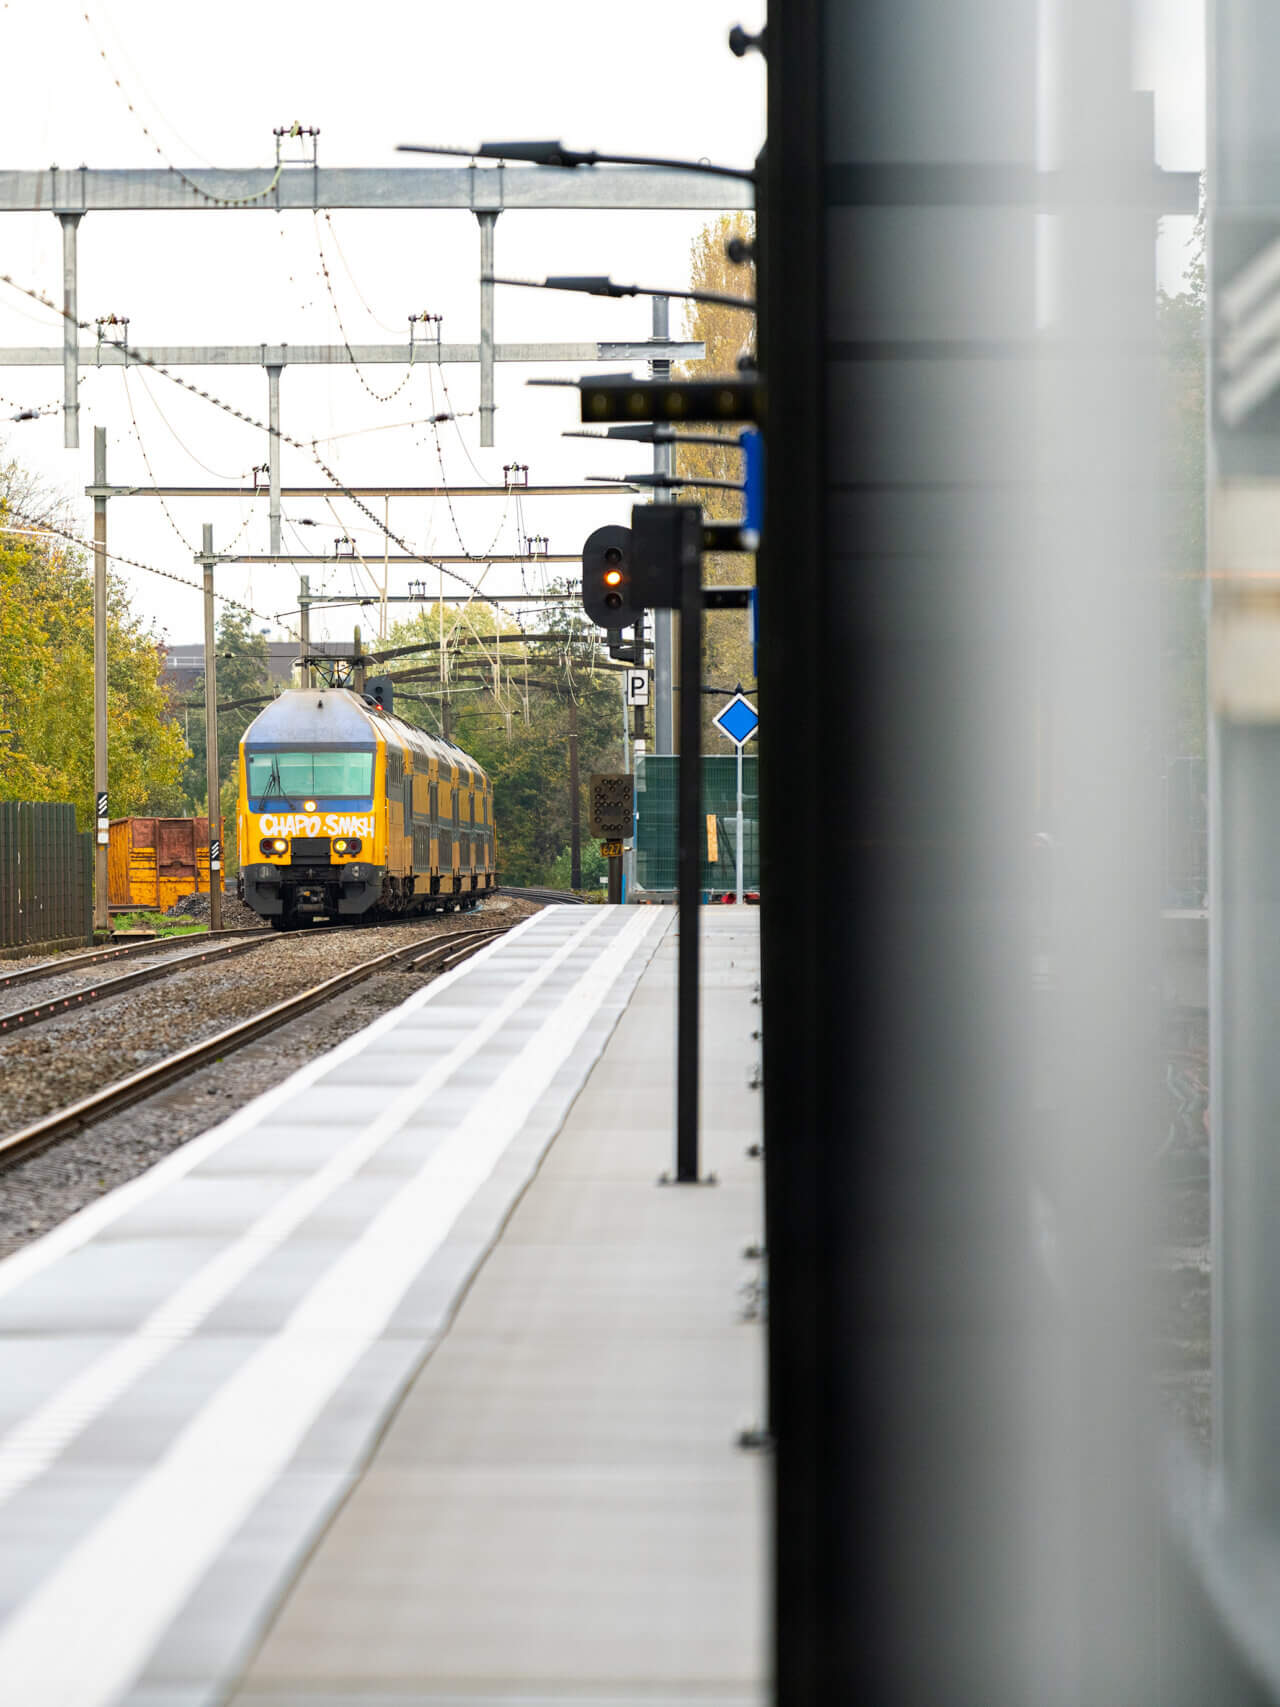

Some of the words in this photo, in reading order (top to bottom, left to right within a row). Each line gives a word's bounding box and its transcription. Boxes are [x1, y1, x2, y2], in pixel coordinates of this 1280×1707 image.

[631, 676, 645, 698] P
[259, 814, 321, 837] CHAPO
[602, 843, 621, 856] 627
